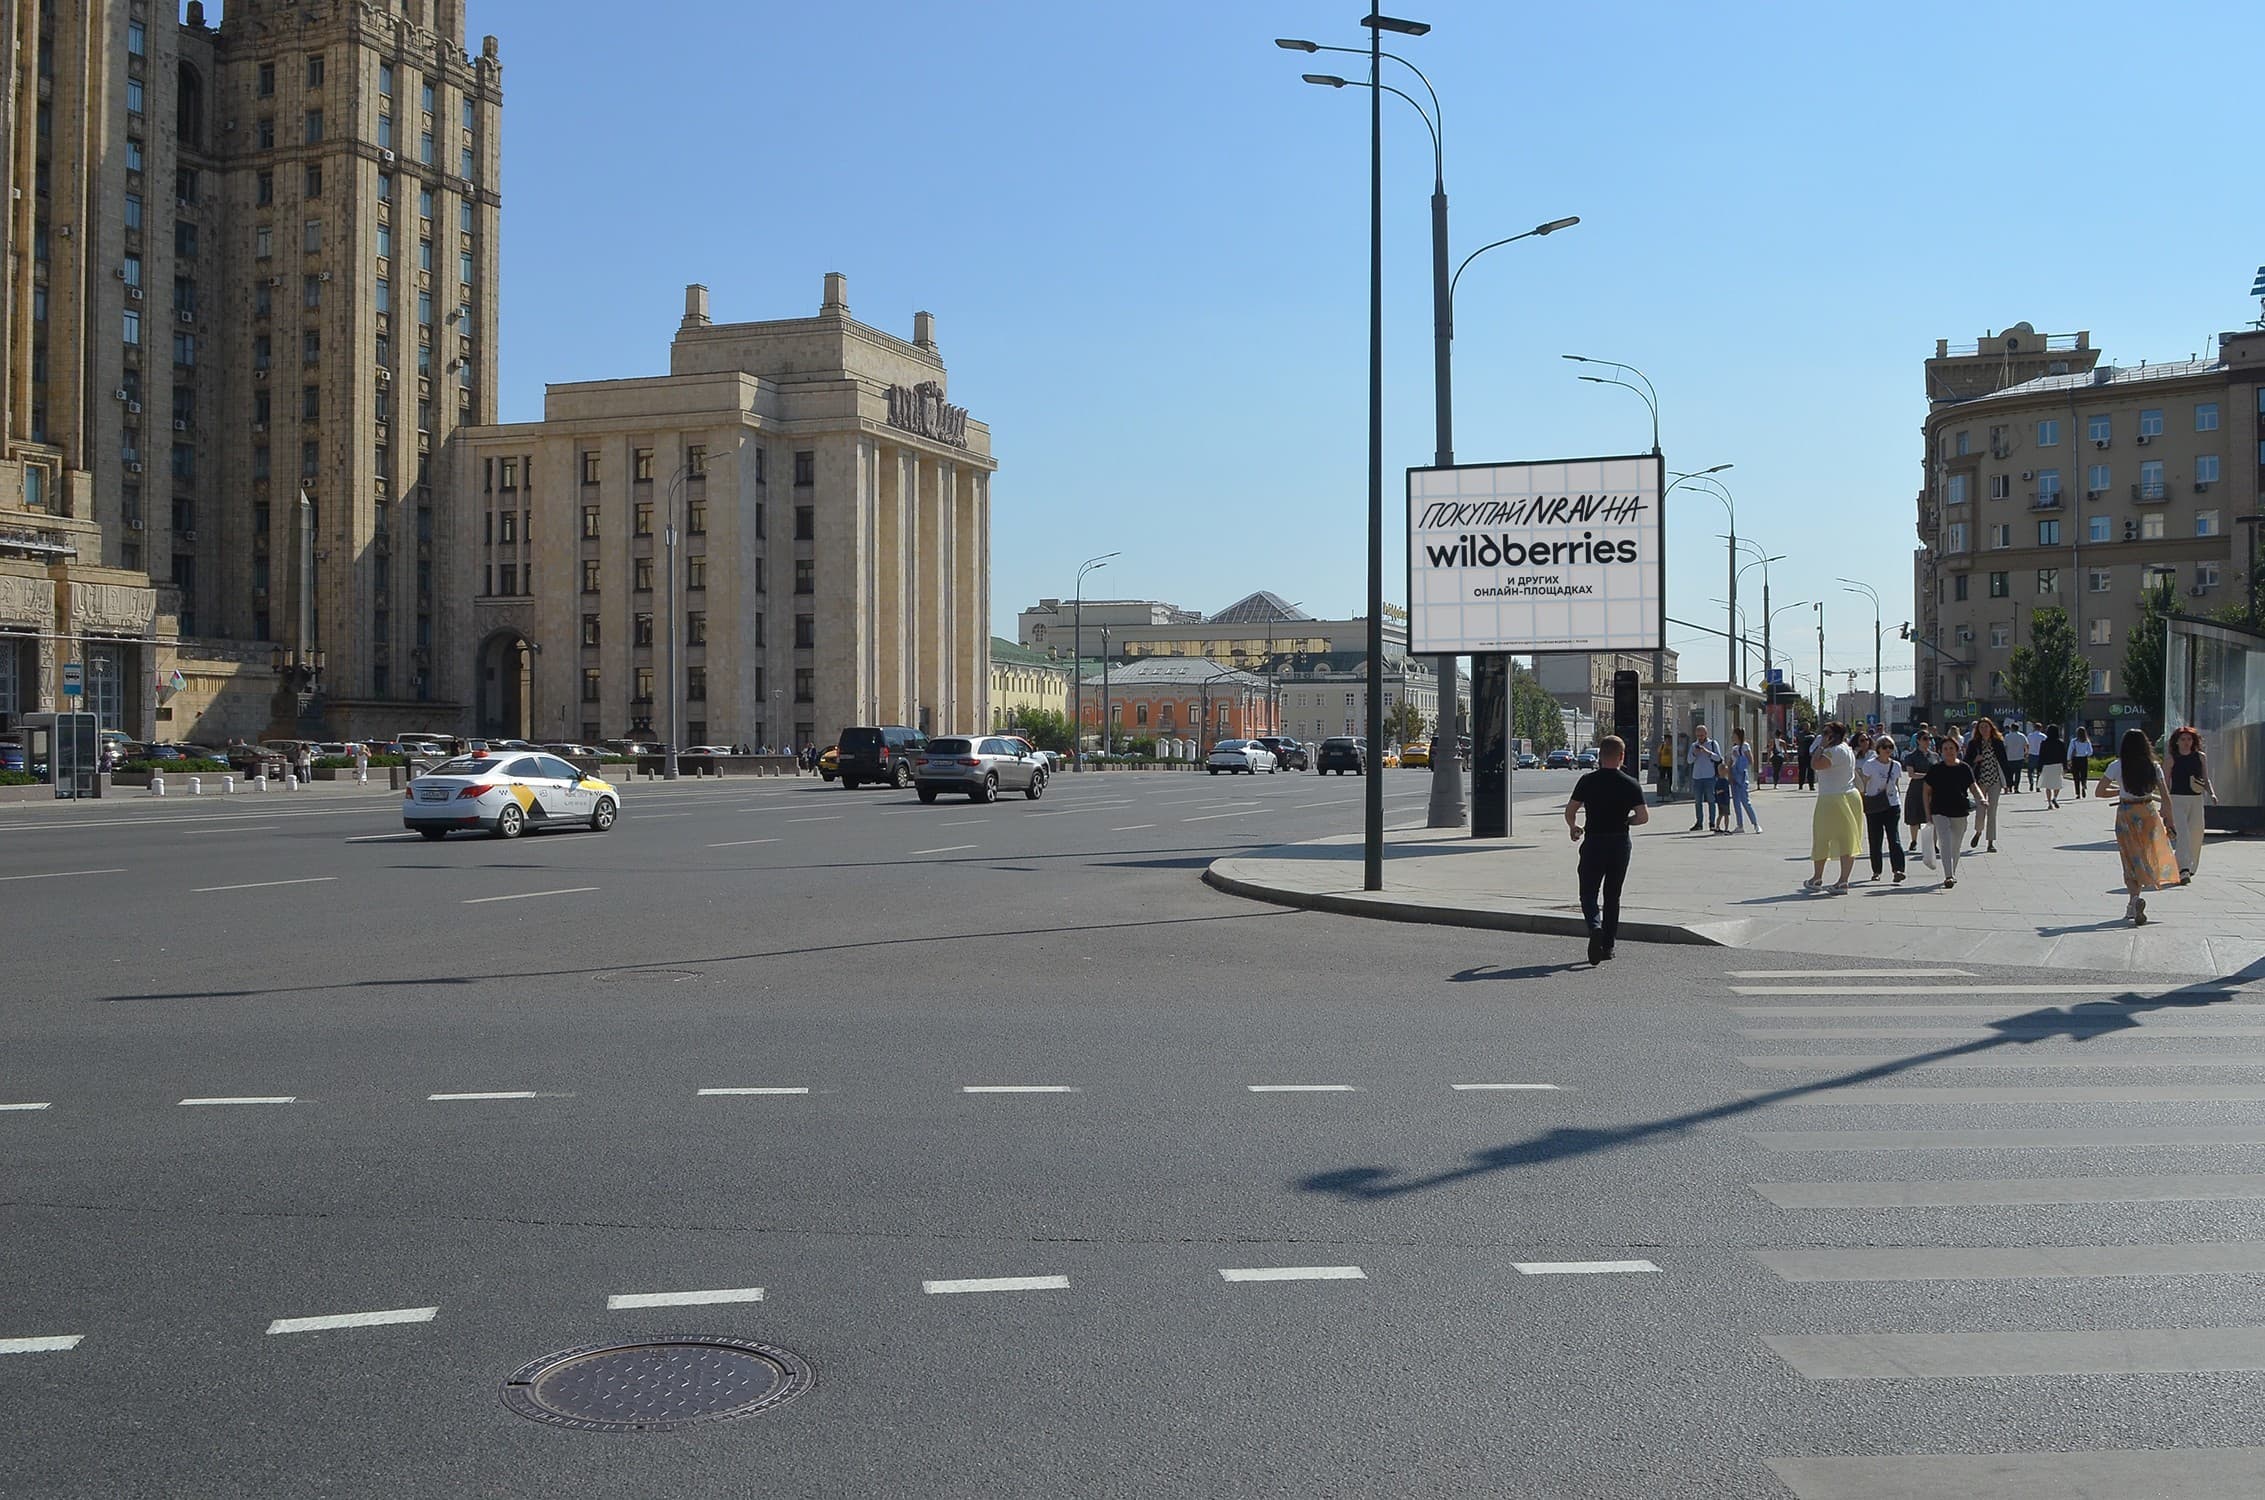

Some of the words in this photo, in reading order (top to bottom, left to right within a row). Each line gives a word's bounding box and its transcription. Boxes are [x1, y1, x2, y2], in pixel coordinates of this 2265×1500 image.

[1418, 499, 1527, 529] ПОКУПАЙ
[1522, 495, 1607, 526] NRAV
[1601, 495, 1649, 525] НА
[1426, 531, 1637, 568] wildberries
[1474, 585, 1592, 597] ОНЛАЙН-ПЛОЩАДКАХ
[1507, 577, 1515, 585] И
[1518, 575, 1559, 586] ДРУГИХ
